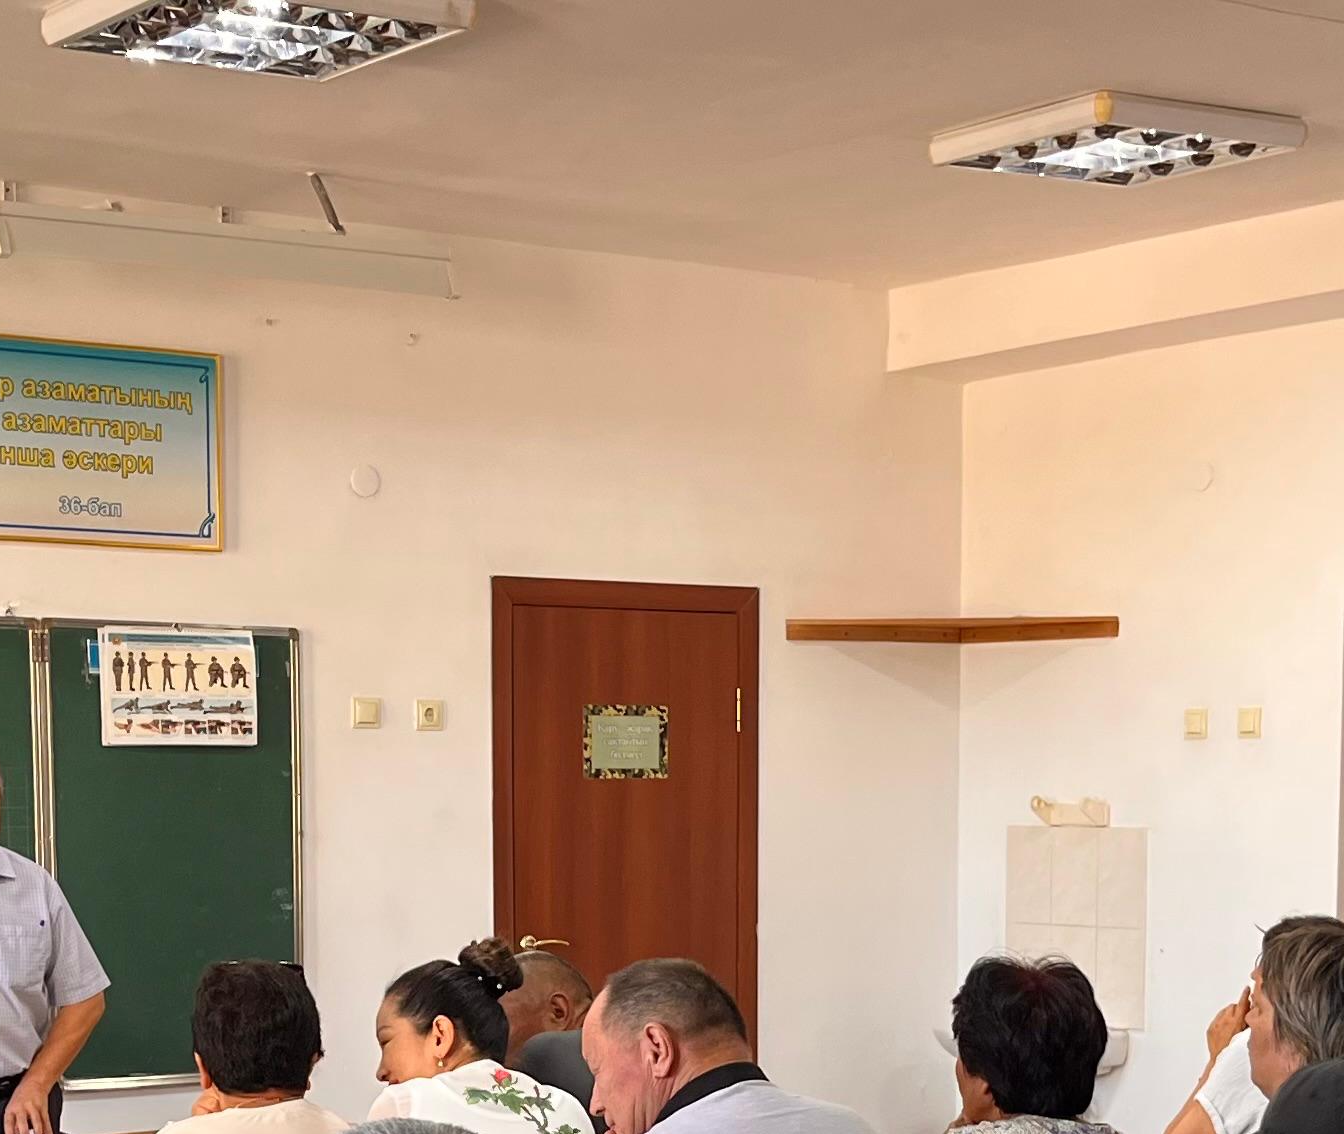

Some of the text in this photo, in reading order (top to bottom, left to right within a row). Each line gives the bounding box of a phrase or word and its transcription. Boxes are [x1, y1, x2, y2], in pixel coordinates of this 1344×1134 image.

[22, 378, 192, 415] азаматының
[2, 412, 162, 445] азаматтары
[62, 450, 153, 479] әскери
[58, 496, 122, 517] 36-бап
